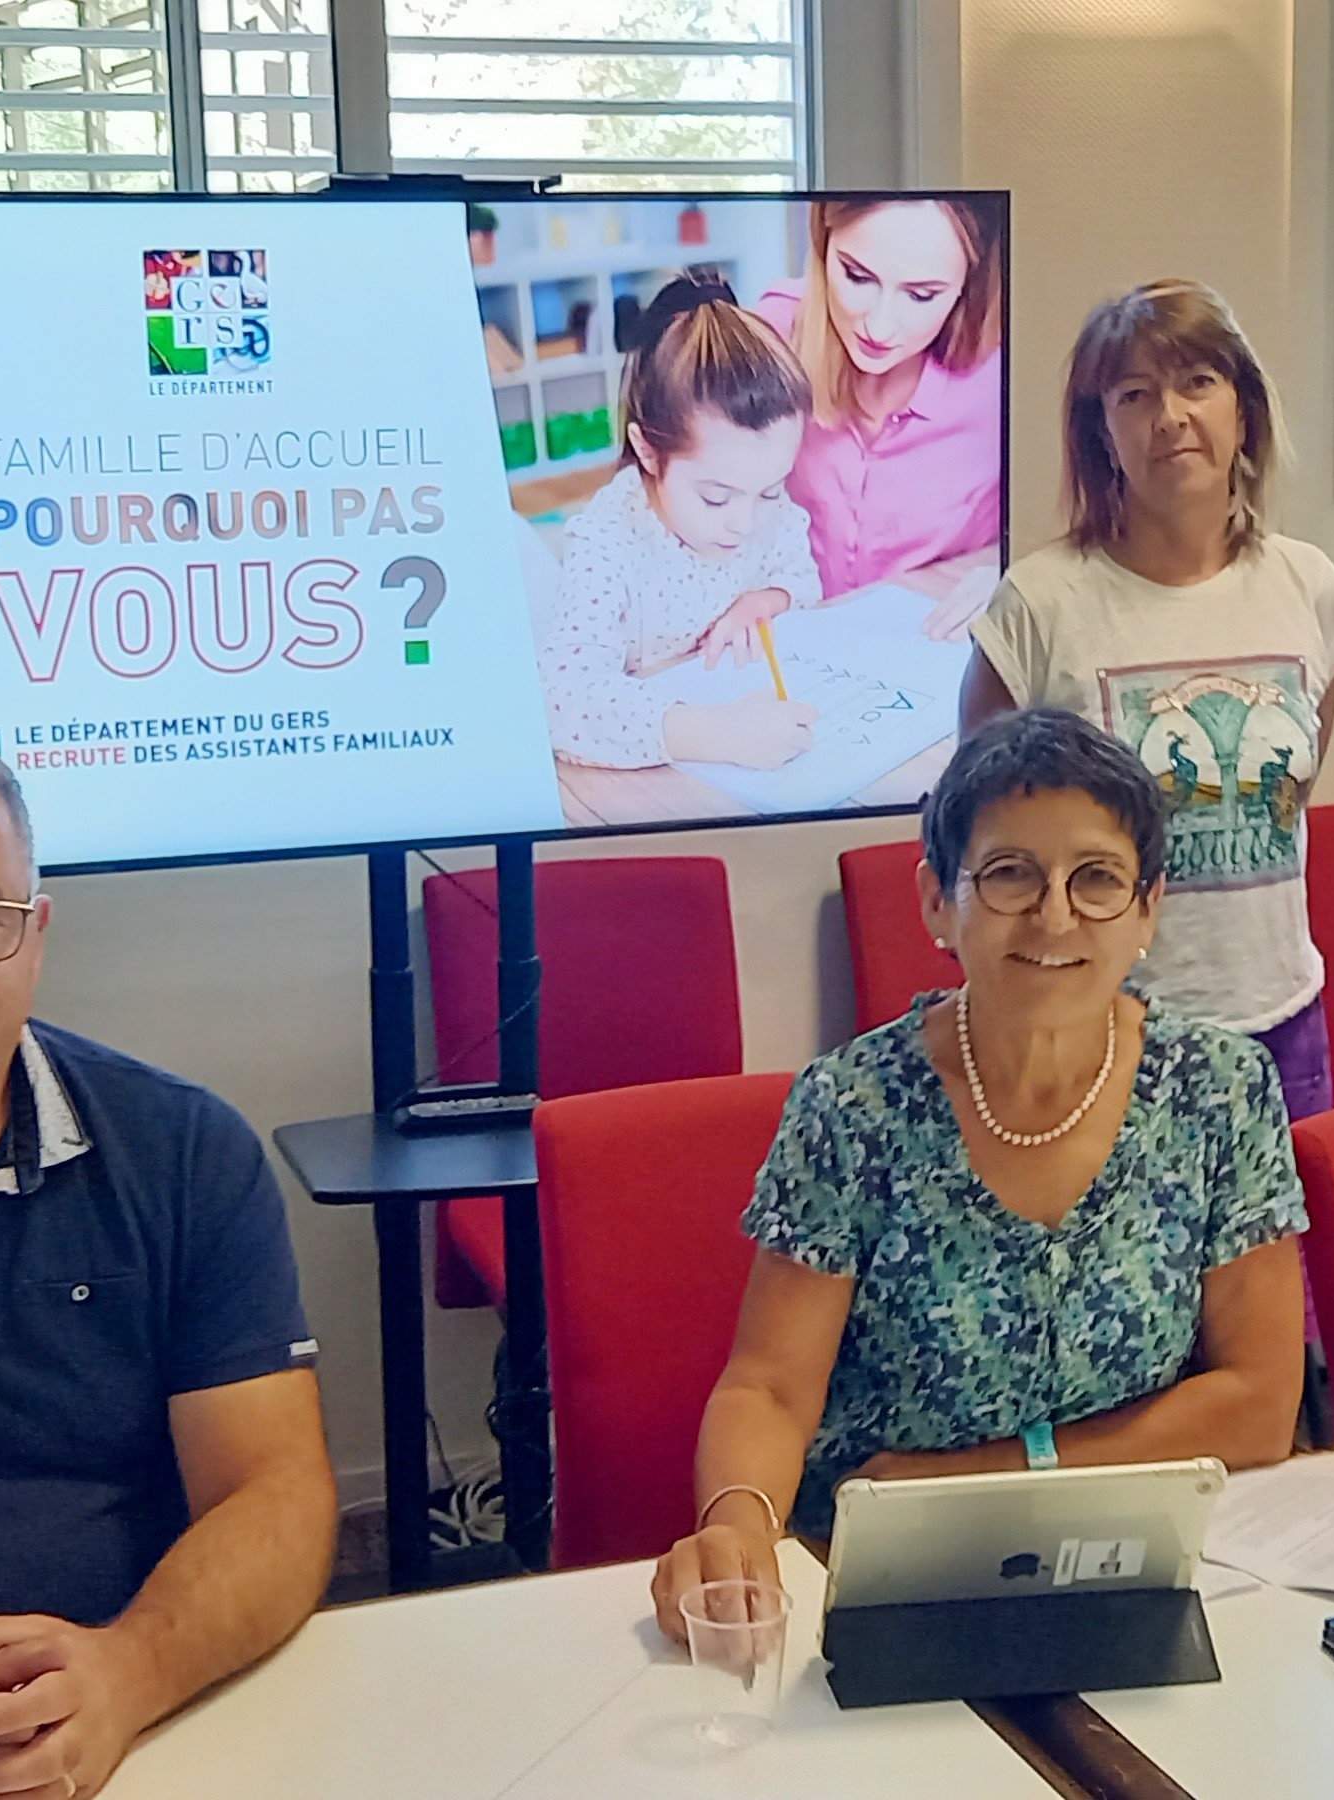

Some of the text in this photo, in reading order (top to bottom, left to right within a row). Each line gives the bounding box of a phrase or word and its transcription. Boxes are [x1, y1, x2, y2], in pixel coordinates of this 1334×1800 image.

[149, 379, 273, 396] LE DÉPARTEMENT
[202, 428, 443, 471] D'ACCUEIL
[331, 485, 446, 538] PAS
[15, 710, 331, 746] LE DÉPARTEMENT DU GERS
[16, 727, 455, 770] RECRUTE DES ASSISTANTS FAMILIAUX
